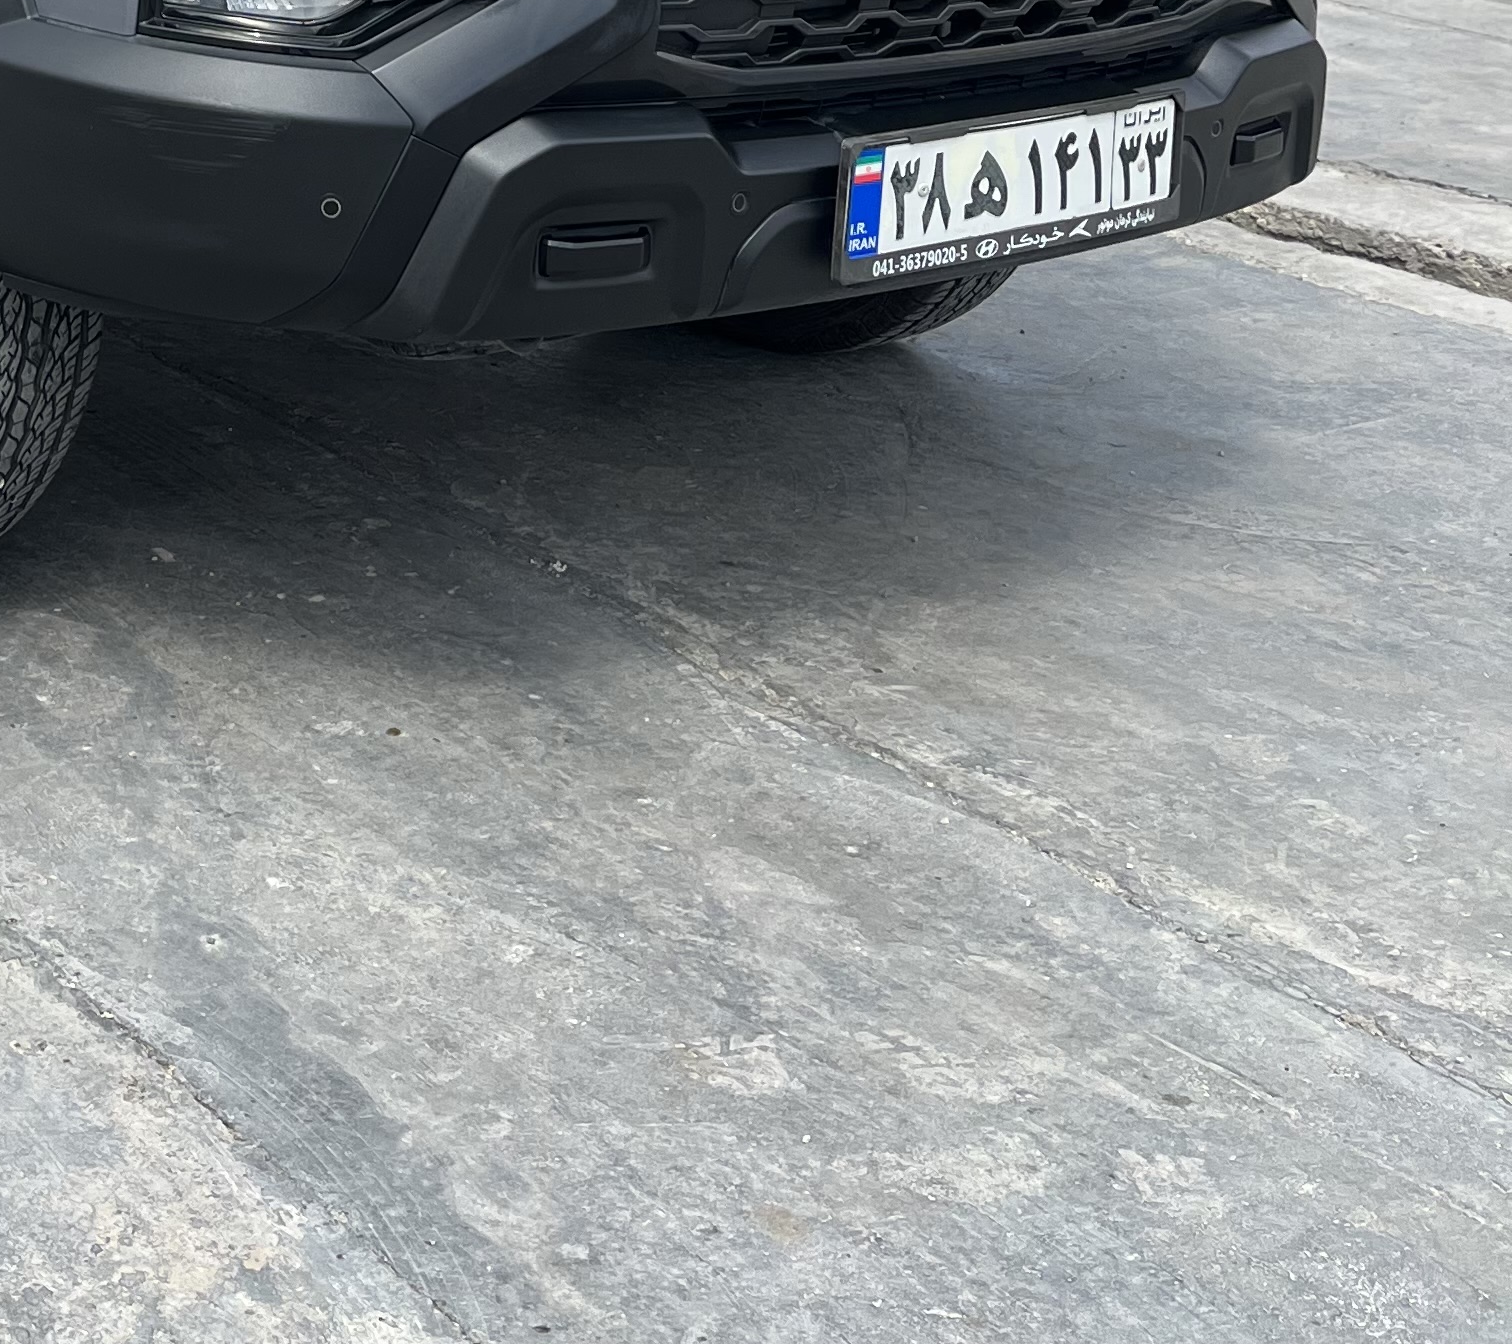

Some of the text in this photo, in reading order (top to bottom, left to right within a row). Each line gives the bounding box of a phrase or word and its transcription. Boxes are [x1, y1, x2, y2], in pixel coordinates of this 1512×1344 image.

[1123, 105, 1167, 128] ایران
[849, 222, 868, 236] I.R.
[1003, 226, 1065, 255] خودکار
[848, 236, 877, 252] IRAN
[872, 244, 968, 277] 041-36379020-5
